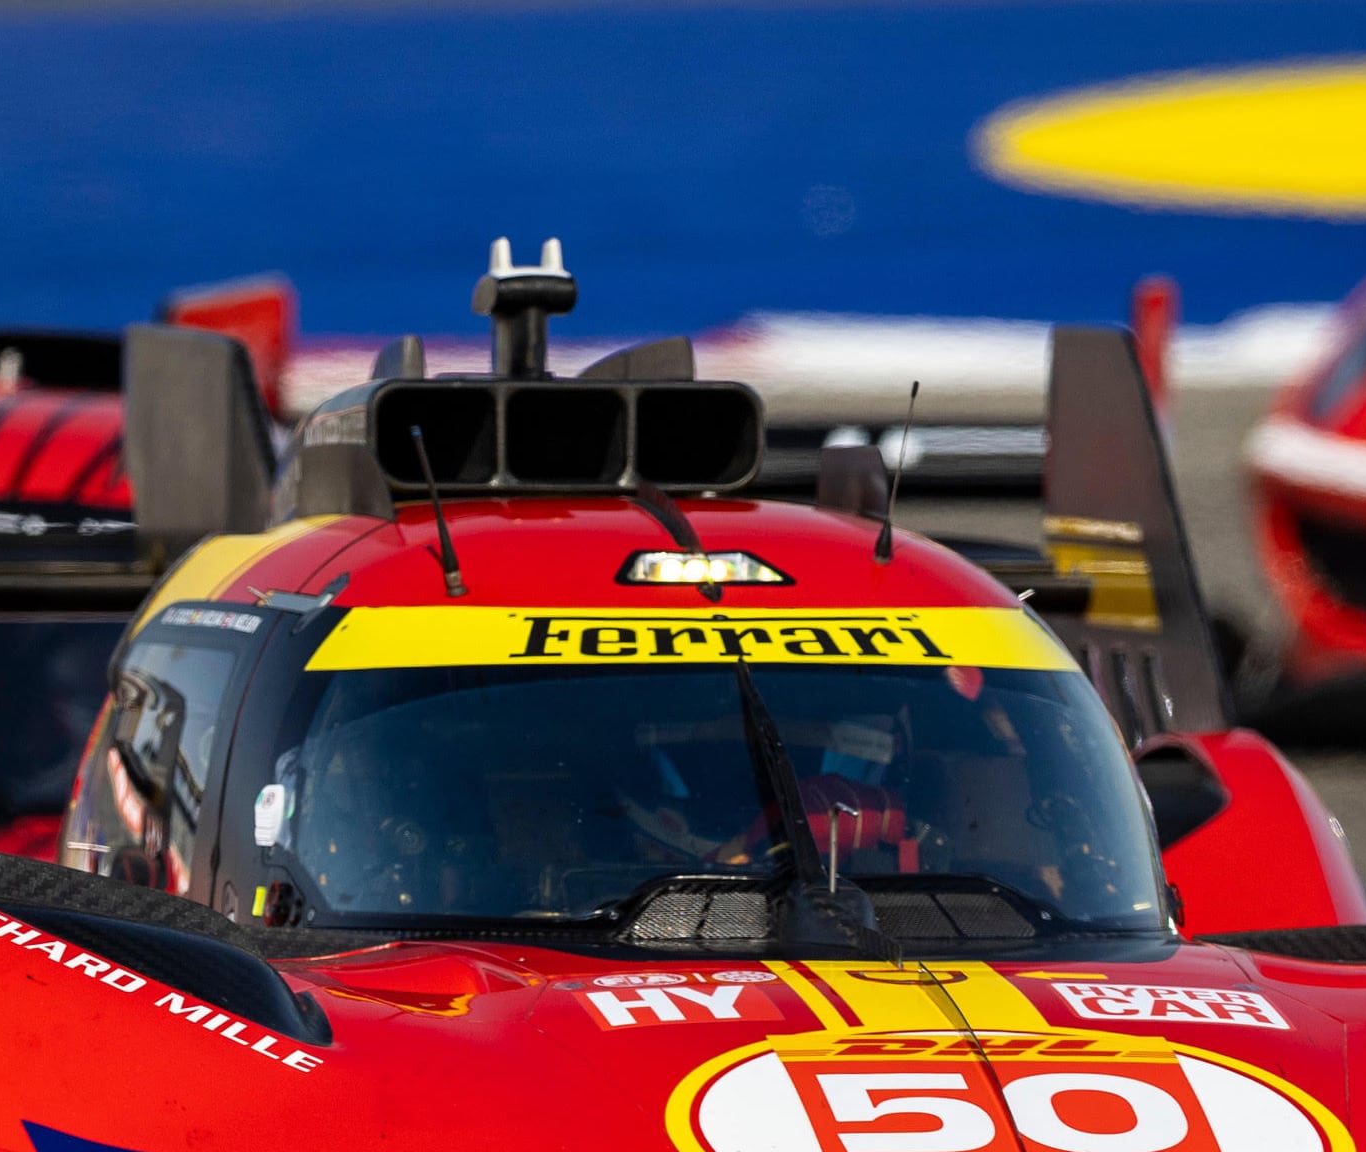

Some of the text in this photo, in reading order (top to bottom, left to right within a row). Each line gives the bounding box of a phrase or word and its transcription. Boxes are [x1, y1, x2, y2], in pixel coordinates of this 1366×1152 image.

[509, 613, 954, 659] Ferrari
[586, 985, 744, 1027] HY
[1065, 985, 1259, 1005] HYPER
[1081, 996, 1277, 1025] CAR
[154, 991, 325, 1074] MILLE
[832, 1038, 1123, 1057] DHL
